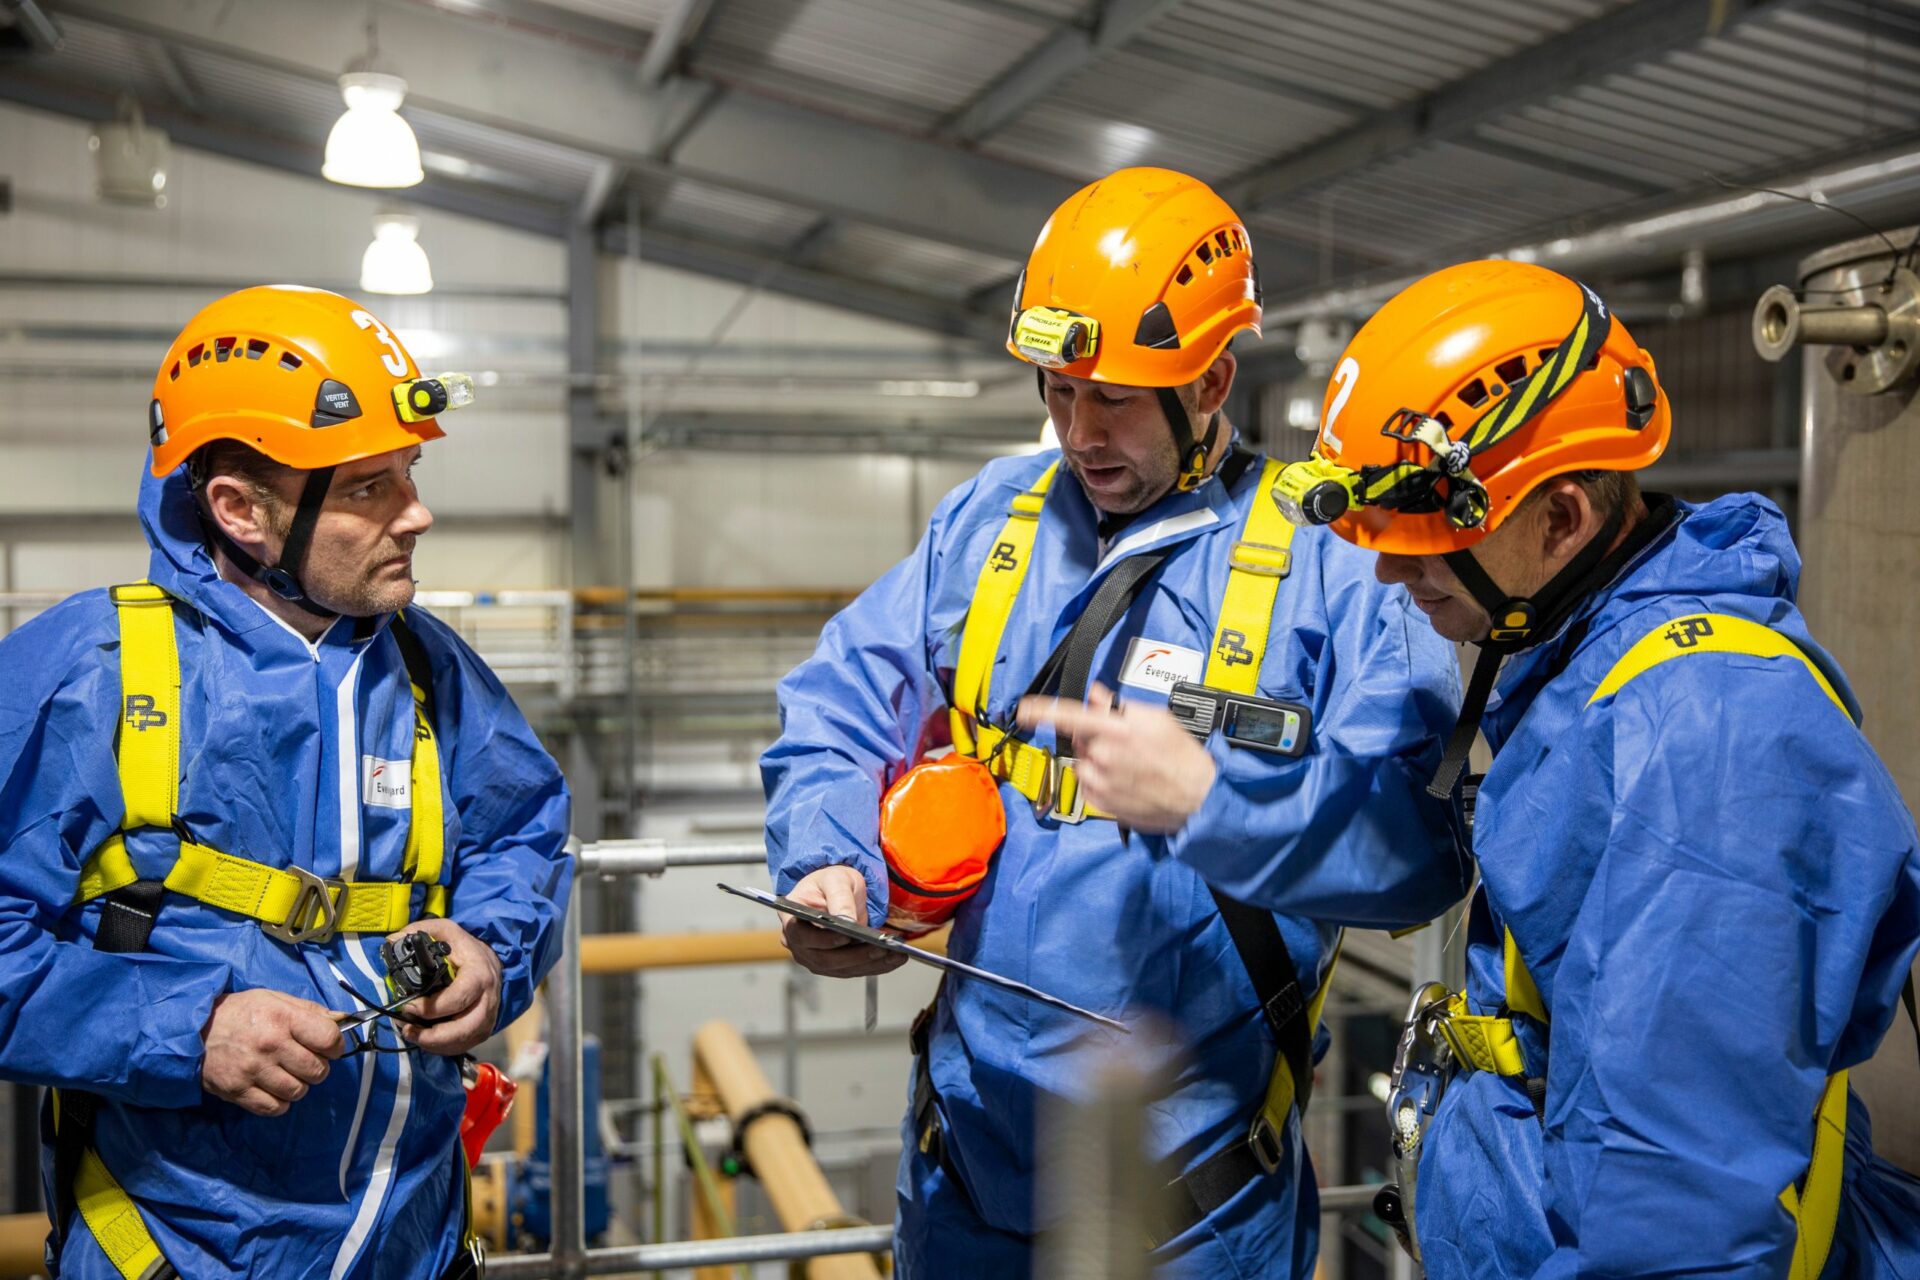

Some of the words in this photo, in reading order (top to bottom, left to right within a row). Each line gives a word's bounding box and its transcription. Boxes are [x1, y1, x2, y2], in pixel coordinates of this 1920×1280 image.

[350, 309, 408, 378] 3
[324, 392, 349, 402] VERTEX
[333, 401, 349, 409] VENT
[1320, 356, 1360, 456] 2
[1145, 664, 1189, 683] Evergard
